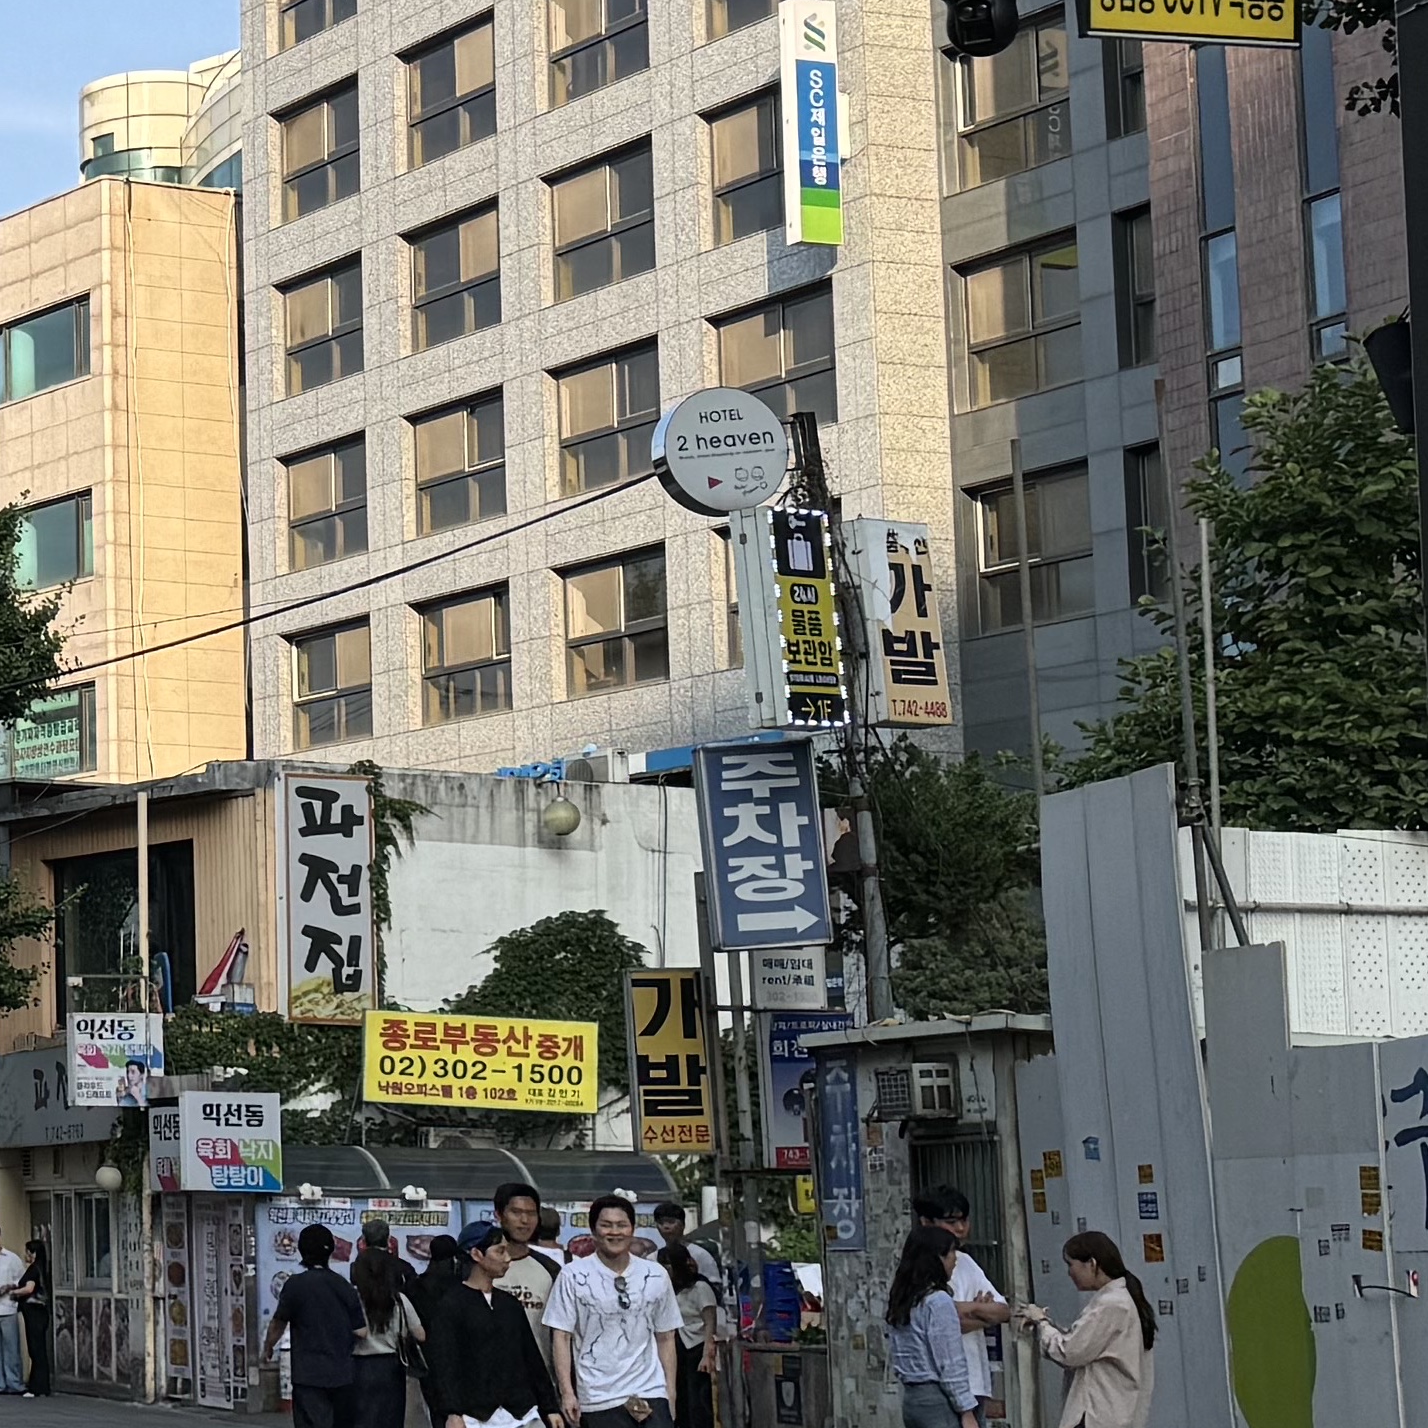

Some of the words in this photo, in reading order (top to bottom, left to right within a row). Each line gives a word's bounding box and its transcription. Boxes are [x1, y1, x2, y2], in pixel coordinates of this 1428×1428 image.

[809, 68, 828, 186] SC제일은행
[699, 409, 743, 423] HOTEL
[677, 436, 688, 451] 2
[696, 431, 774, 449] heaven
[792, 610, 822, 636] 물품
[882, 563, 940, 685] 가발
[786, 640, 833, 666] 보관함
[818, 700, 832, 720] 1F
[721, 752, 814, 902] 주차장
[294, 784, 364, 995] 파전집
[76, 1018, 136, 1041] 익선동
[379, 1019, 533, 1057] 종로부동산
[536, 1033, 584, 1062] 중개
[632, 978, 706, 1116] 가발
[379, 1055, 582, 1085] 02)302-1500
[378, 1081, 453, 1099] 낙원오피스텔
[458, 1086, 478, 1100] 1층
[483, 1087, 518, 1101] 102호
[202, 1103, 264, 1127] 익선동
[643, 1124, 710, 1144] 수선전문
[197, 1138, 232, 1160] 육회
[238, 1139, 274, 1161] 낙지
[211, 1166, 264, 1187] 탕탕이
